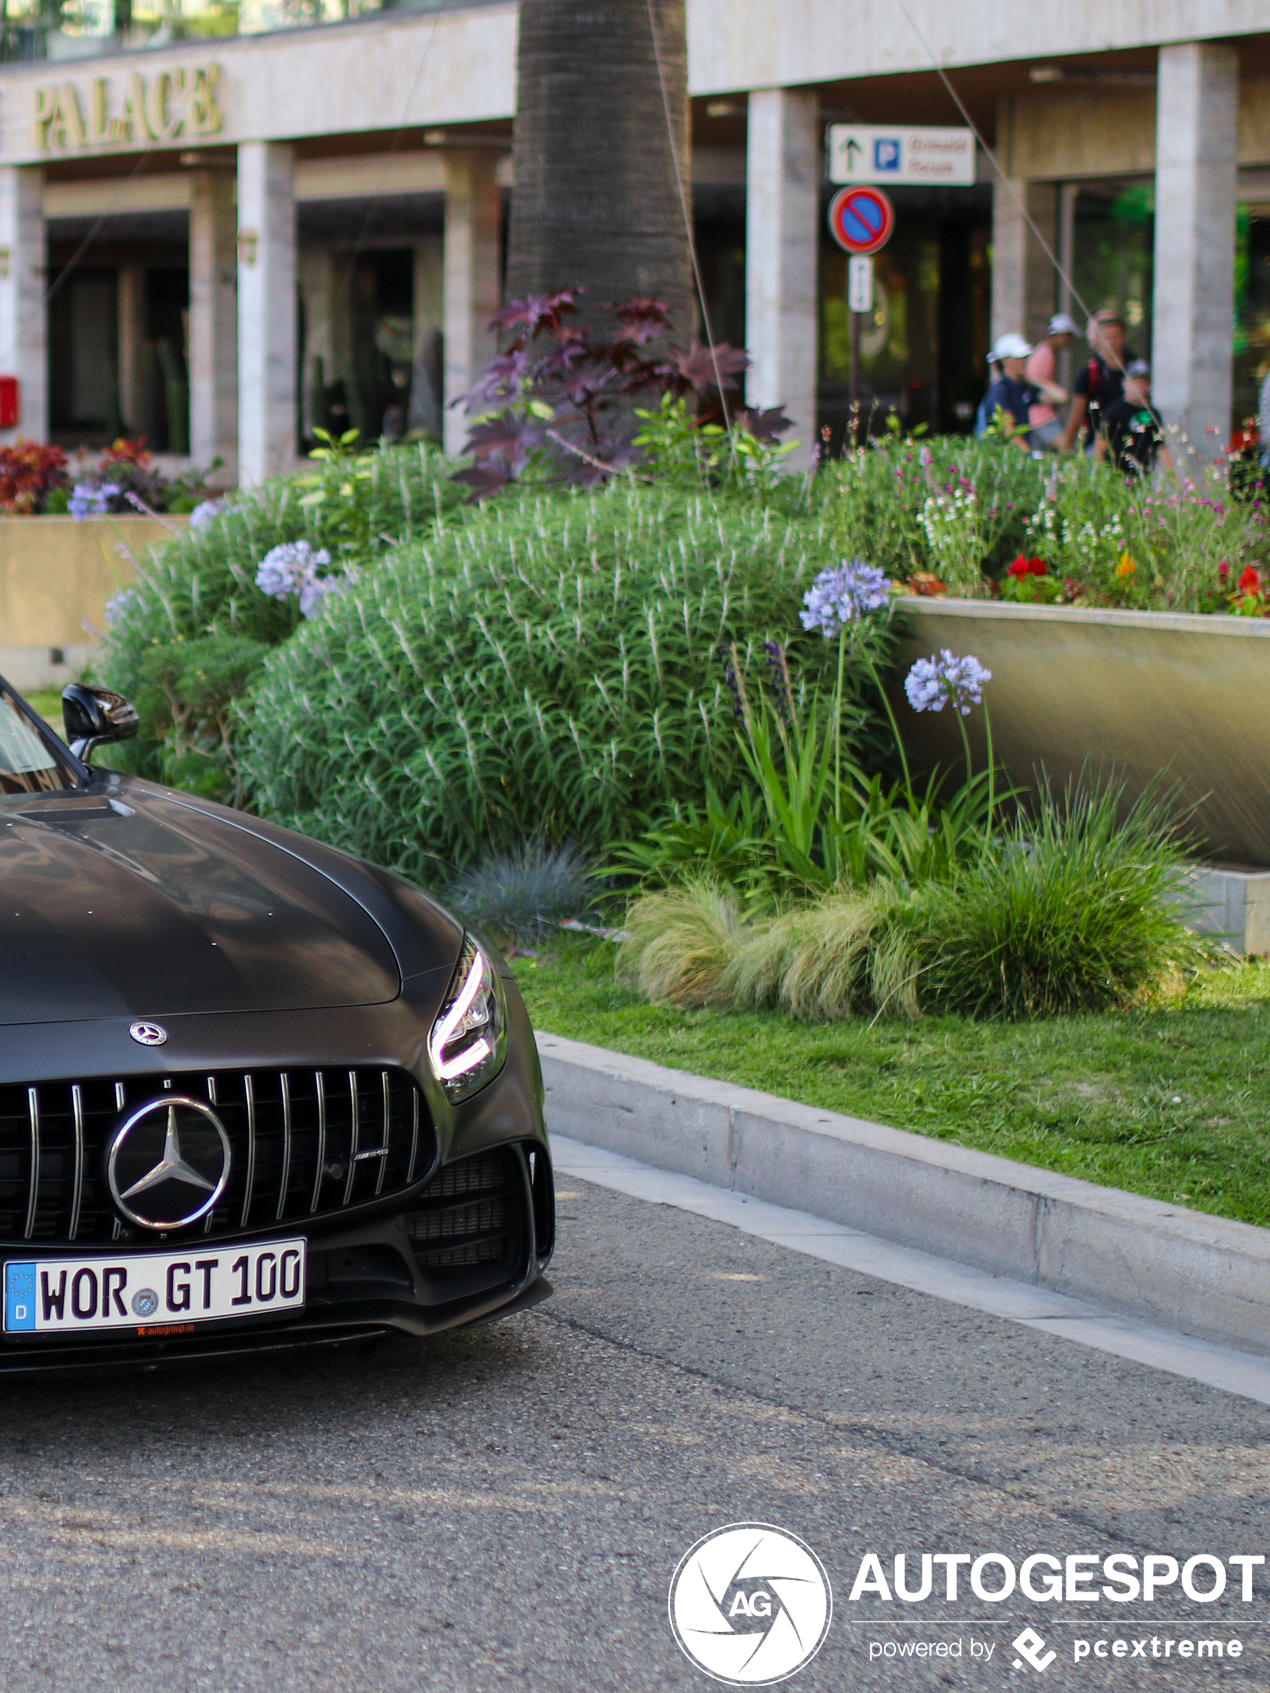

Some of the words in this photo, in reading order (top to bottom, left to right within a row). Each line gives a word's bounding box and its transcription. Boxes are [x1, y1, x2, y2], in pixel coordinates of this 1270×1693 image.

[32, 62, 223, 152] PALACE
[15, 1305, 27, 1320] D
[40, 1266, 128, 1320] WOR
[165, 1259, 219, 1313] GT
[230, 1249, 300, 1306] 100
